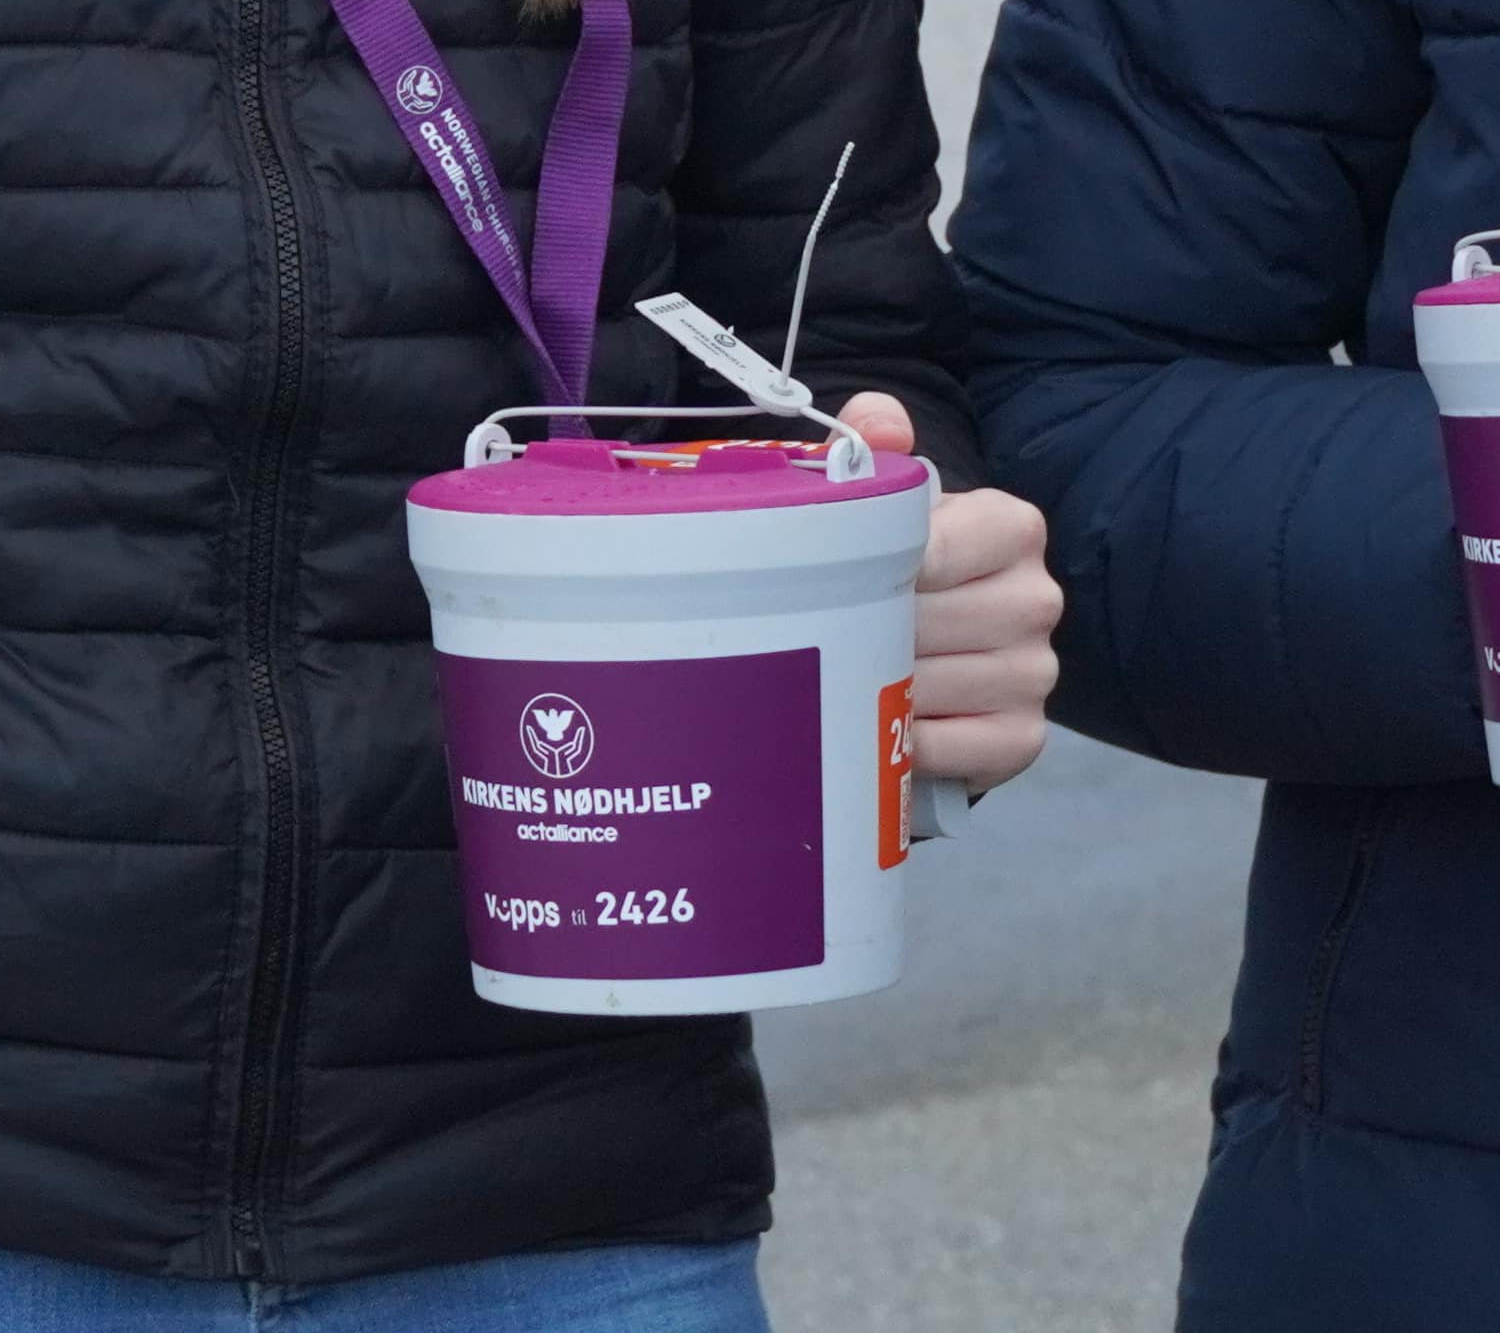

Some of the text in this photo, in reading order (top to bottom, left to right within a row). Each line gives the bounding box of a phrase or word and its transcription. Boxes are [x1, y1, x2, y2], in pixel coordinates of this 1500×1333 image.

[419, 121, 484, 232] actalliance
[440, 107, 517, 267] NORWEGIAN CHURCH
[462, 775, 712, 817] KIRKENS NØDHJELP
[517, 821, 619, 843] actalliance
[571, 909, 588, 926] til
[595, 888, 696, 927] 2426
